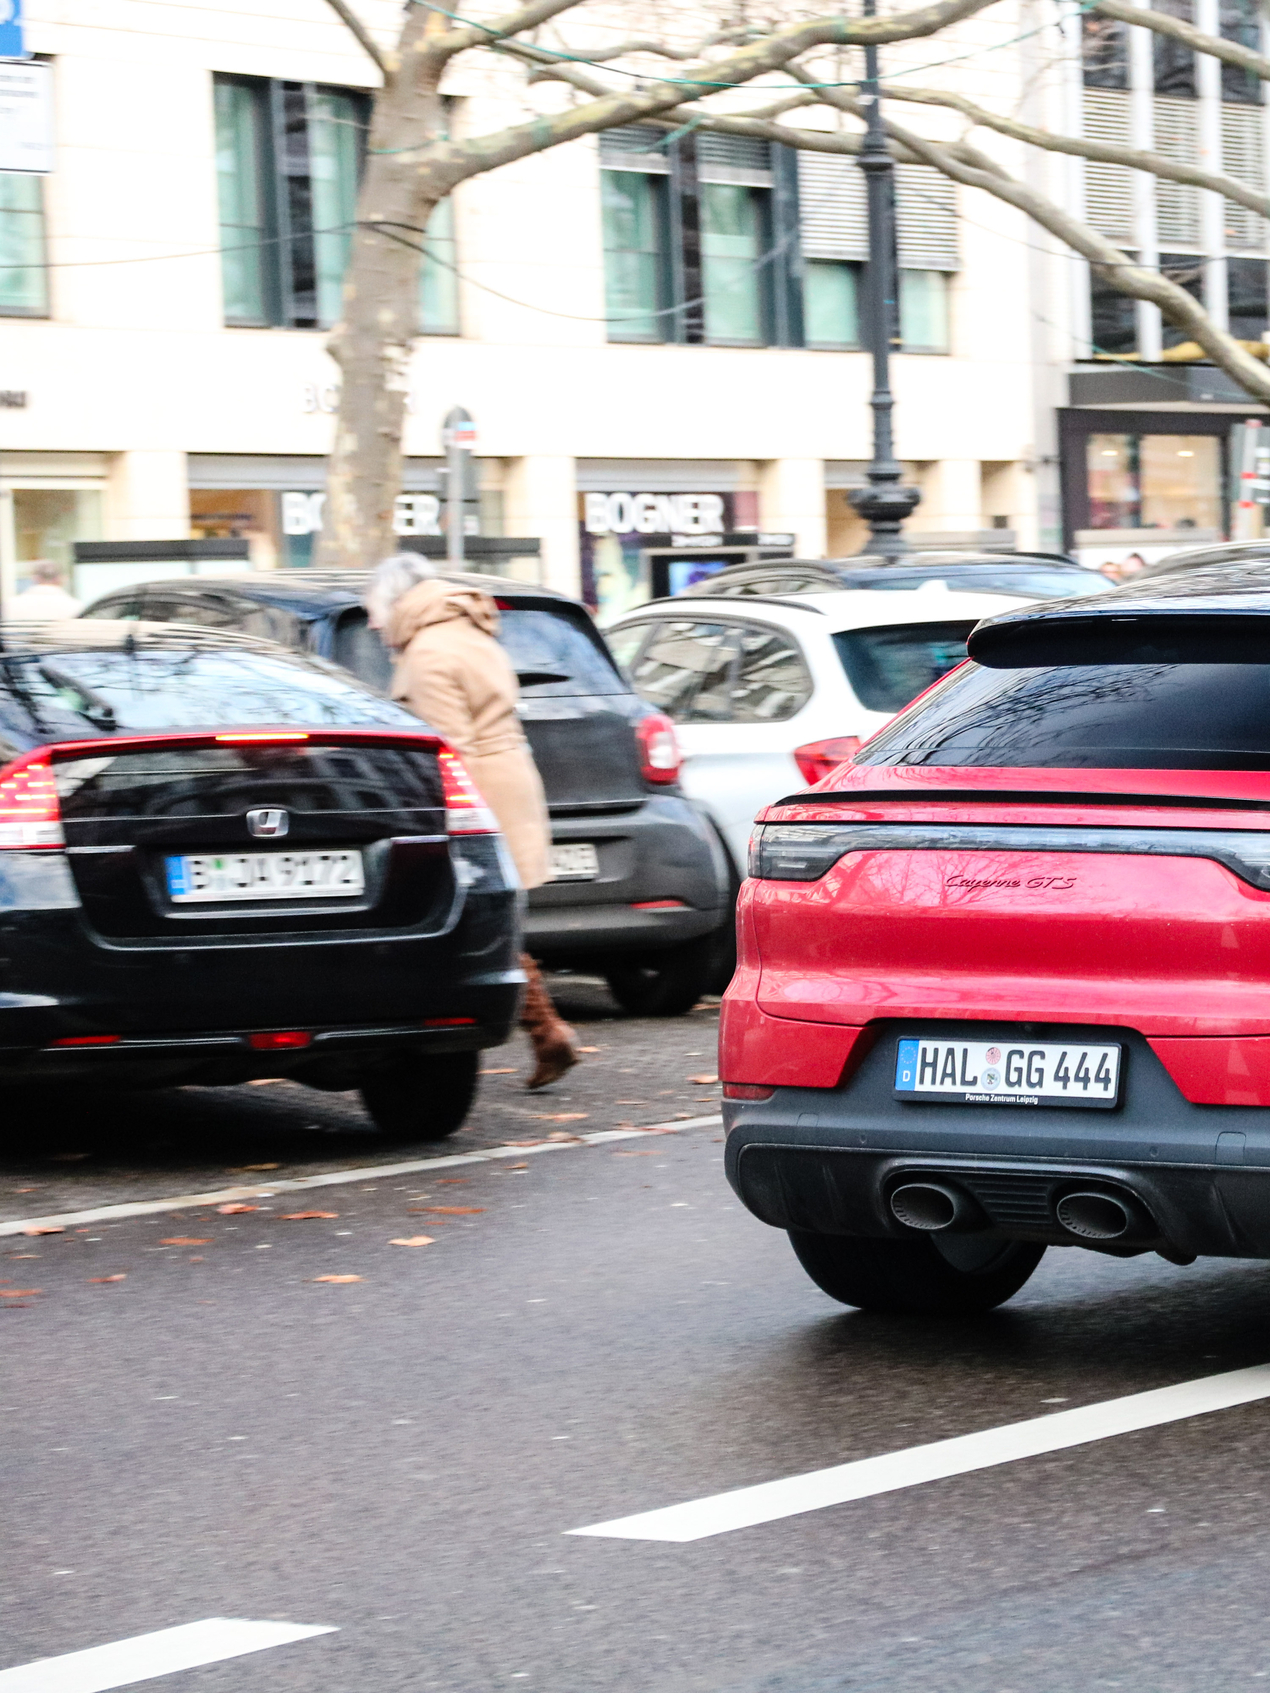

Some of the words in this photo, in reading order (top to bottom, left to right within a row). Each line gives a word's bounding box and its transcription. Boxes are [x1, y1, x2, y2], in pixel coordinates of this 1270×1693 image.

[282, 492, 442, 536] BOER
[585, 492, 726, 534] BOGNER
[278, 852, 358, 886] 9172
[945, 874, 1021, 893] Cayenne
[1025, 876, 1077, 890] GTS
[902, 1070, 911, 1082] D
[918, 1046, 978, 1087] HAL
[1004, 1049, 1046, 1089] GG
[1053, 1051, 1112, 1092] 444
[965, 1093, 990, 1102] Porsche
[990, 1094, 1016, 1103] Zentrum
[1016, 1095, 1039, 1105] Leipzig
